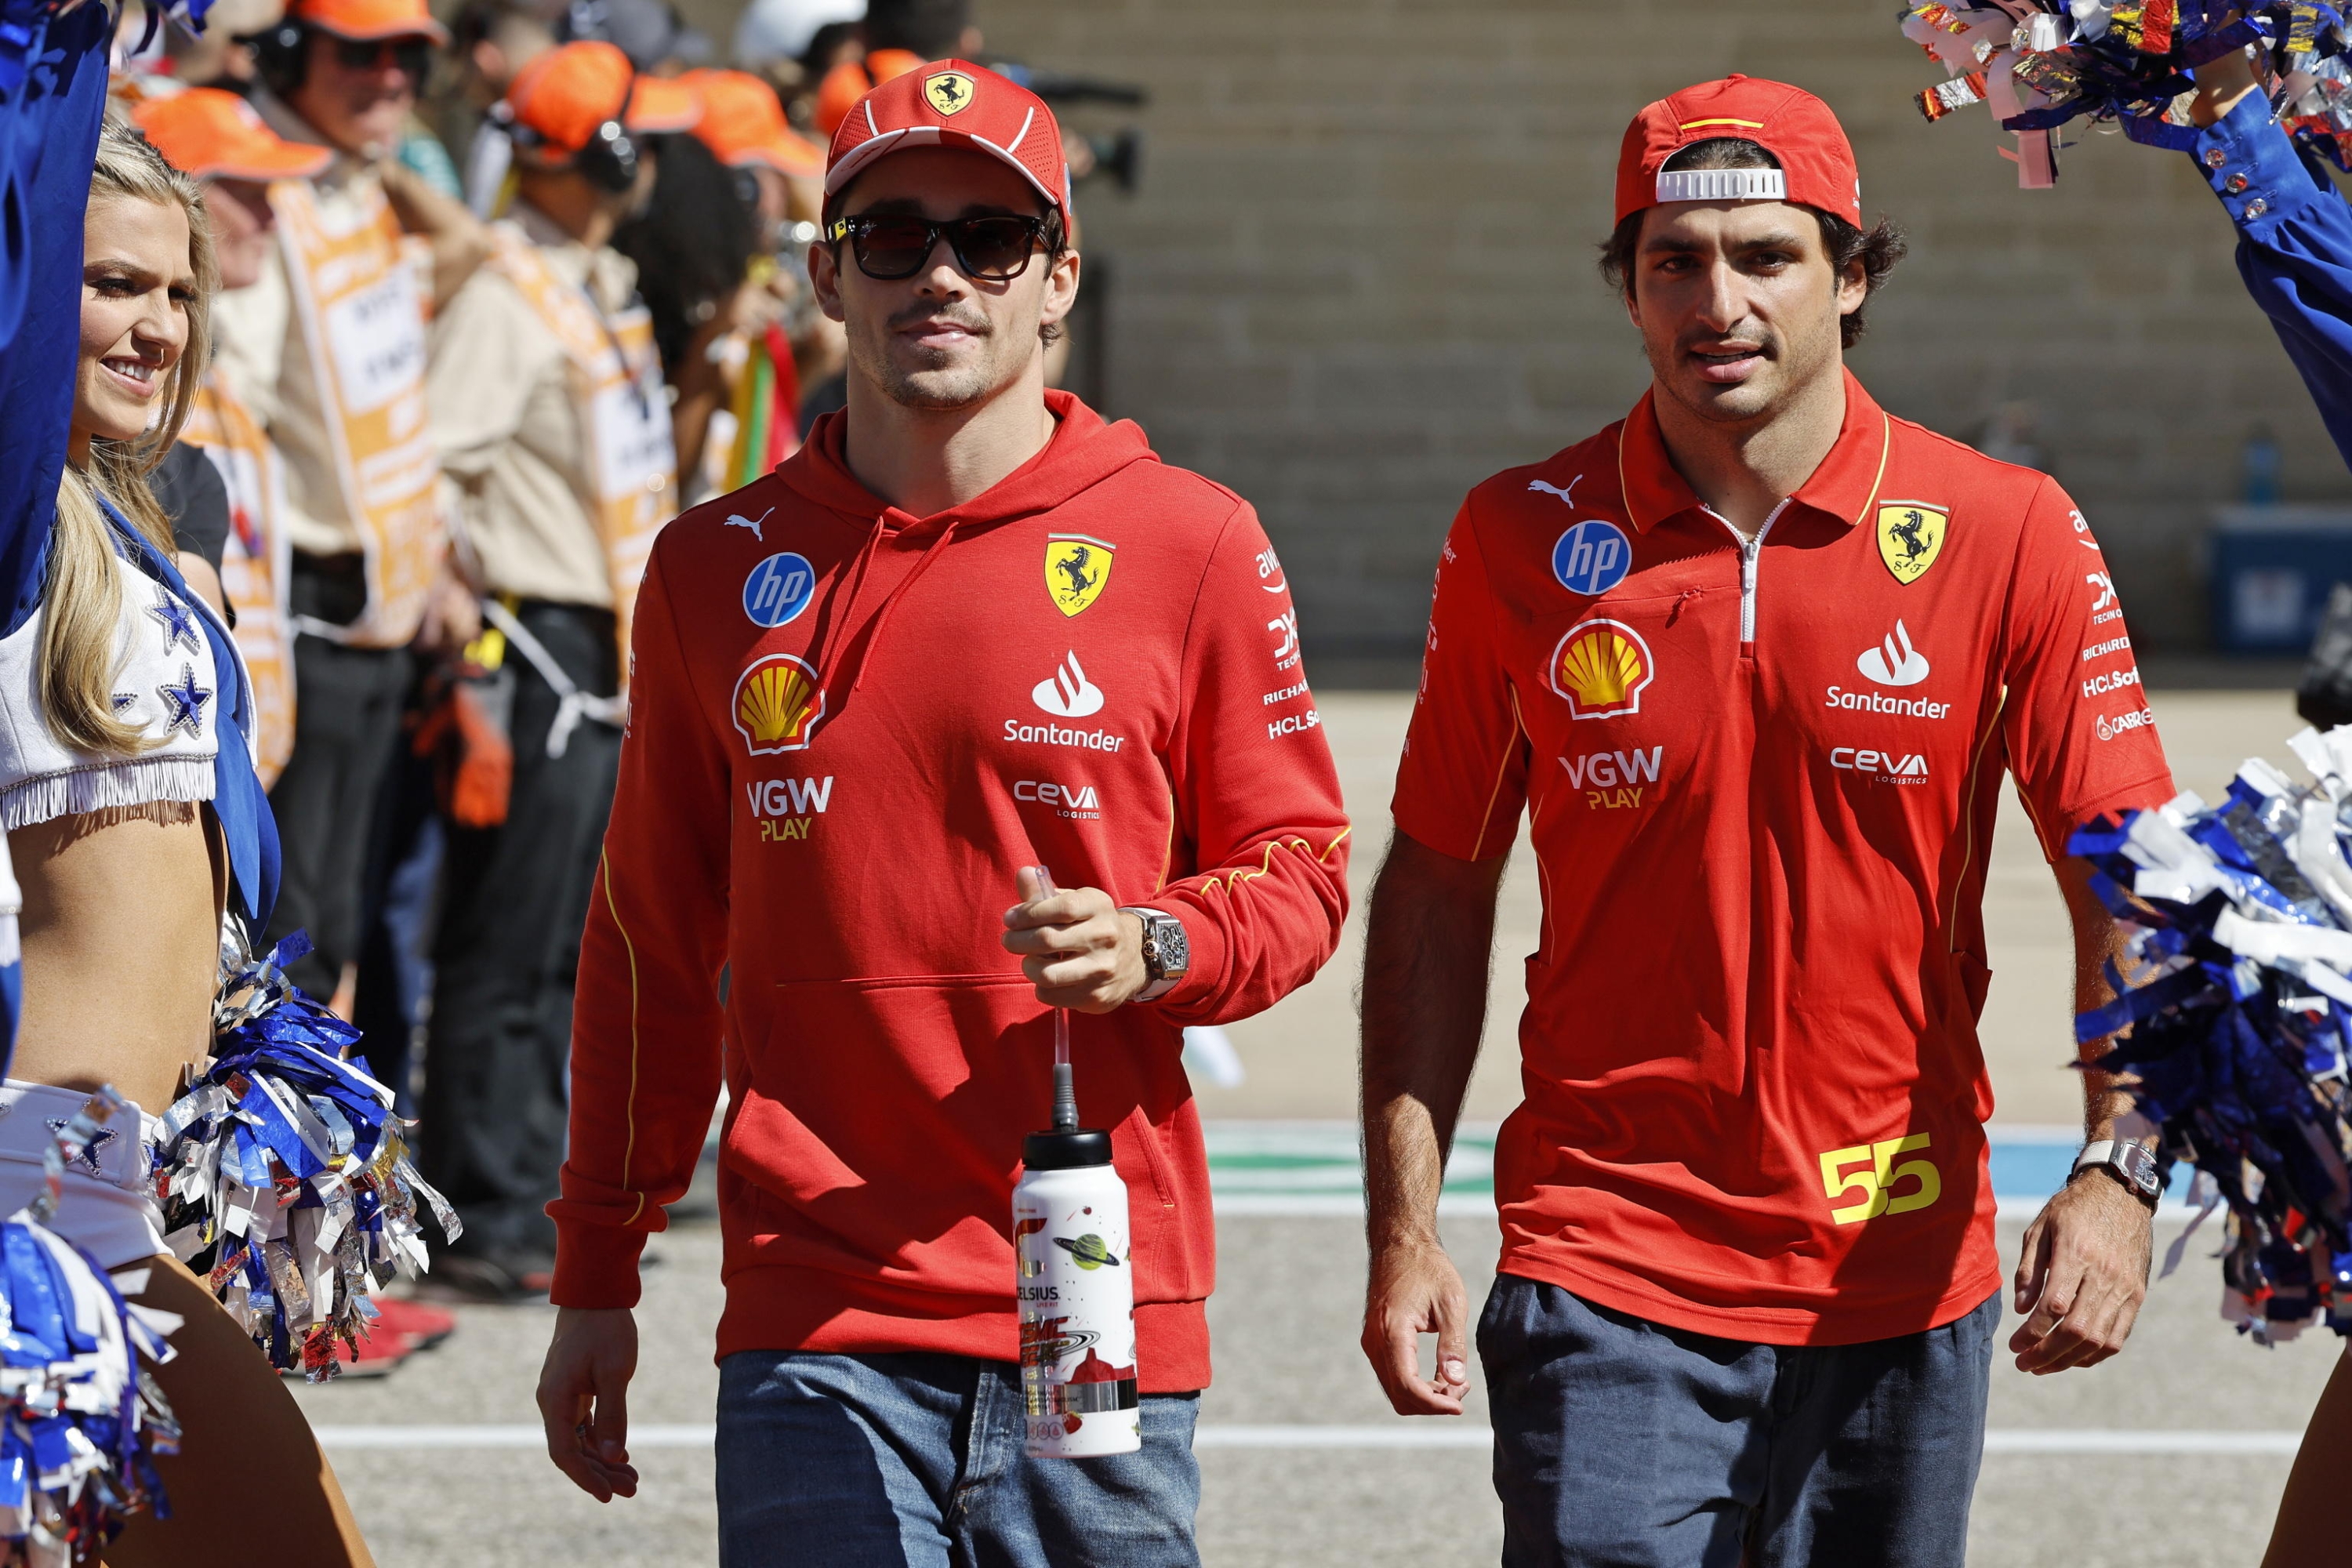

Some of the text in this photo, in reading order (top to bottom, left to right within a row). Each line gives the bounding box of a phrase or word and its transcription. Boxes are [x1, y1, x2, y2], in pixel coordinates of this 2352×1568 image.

[1565, 521, 1621, 595] hp
[752, 553, 808, 627] hp
[1825, 685, 1951, 720] Santander
[1003, 719, 1124, 753] Santander
[1557, 745, 1663, 790] VGW
[1875, 775, 1927, 785] LOGISTICS
[746, 775, 834, 818] VGW
[1585, 787, 1643, 810] PLAY
[760, 817, 812, 842] PLAY
[1057, 809, 1101, 820] LOGISTICS
[1819, 1131, 1941, 1225] 55
